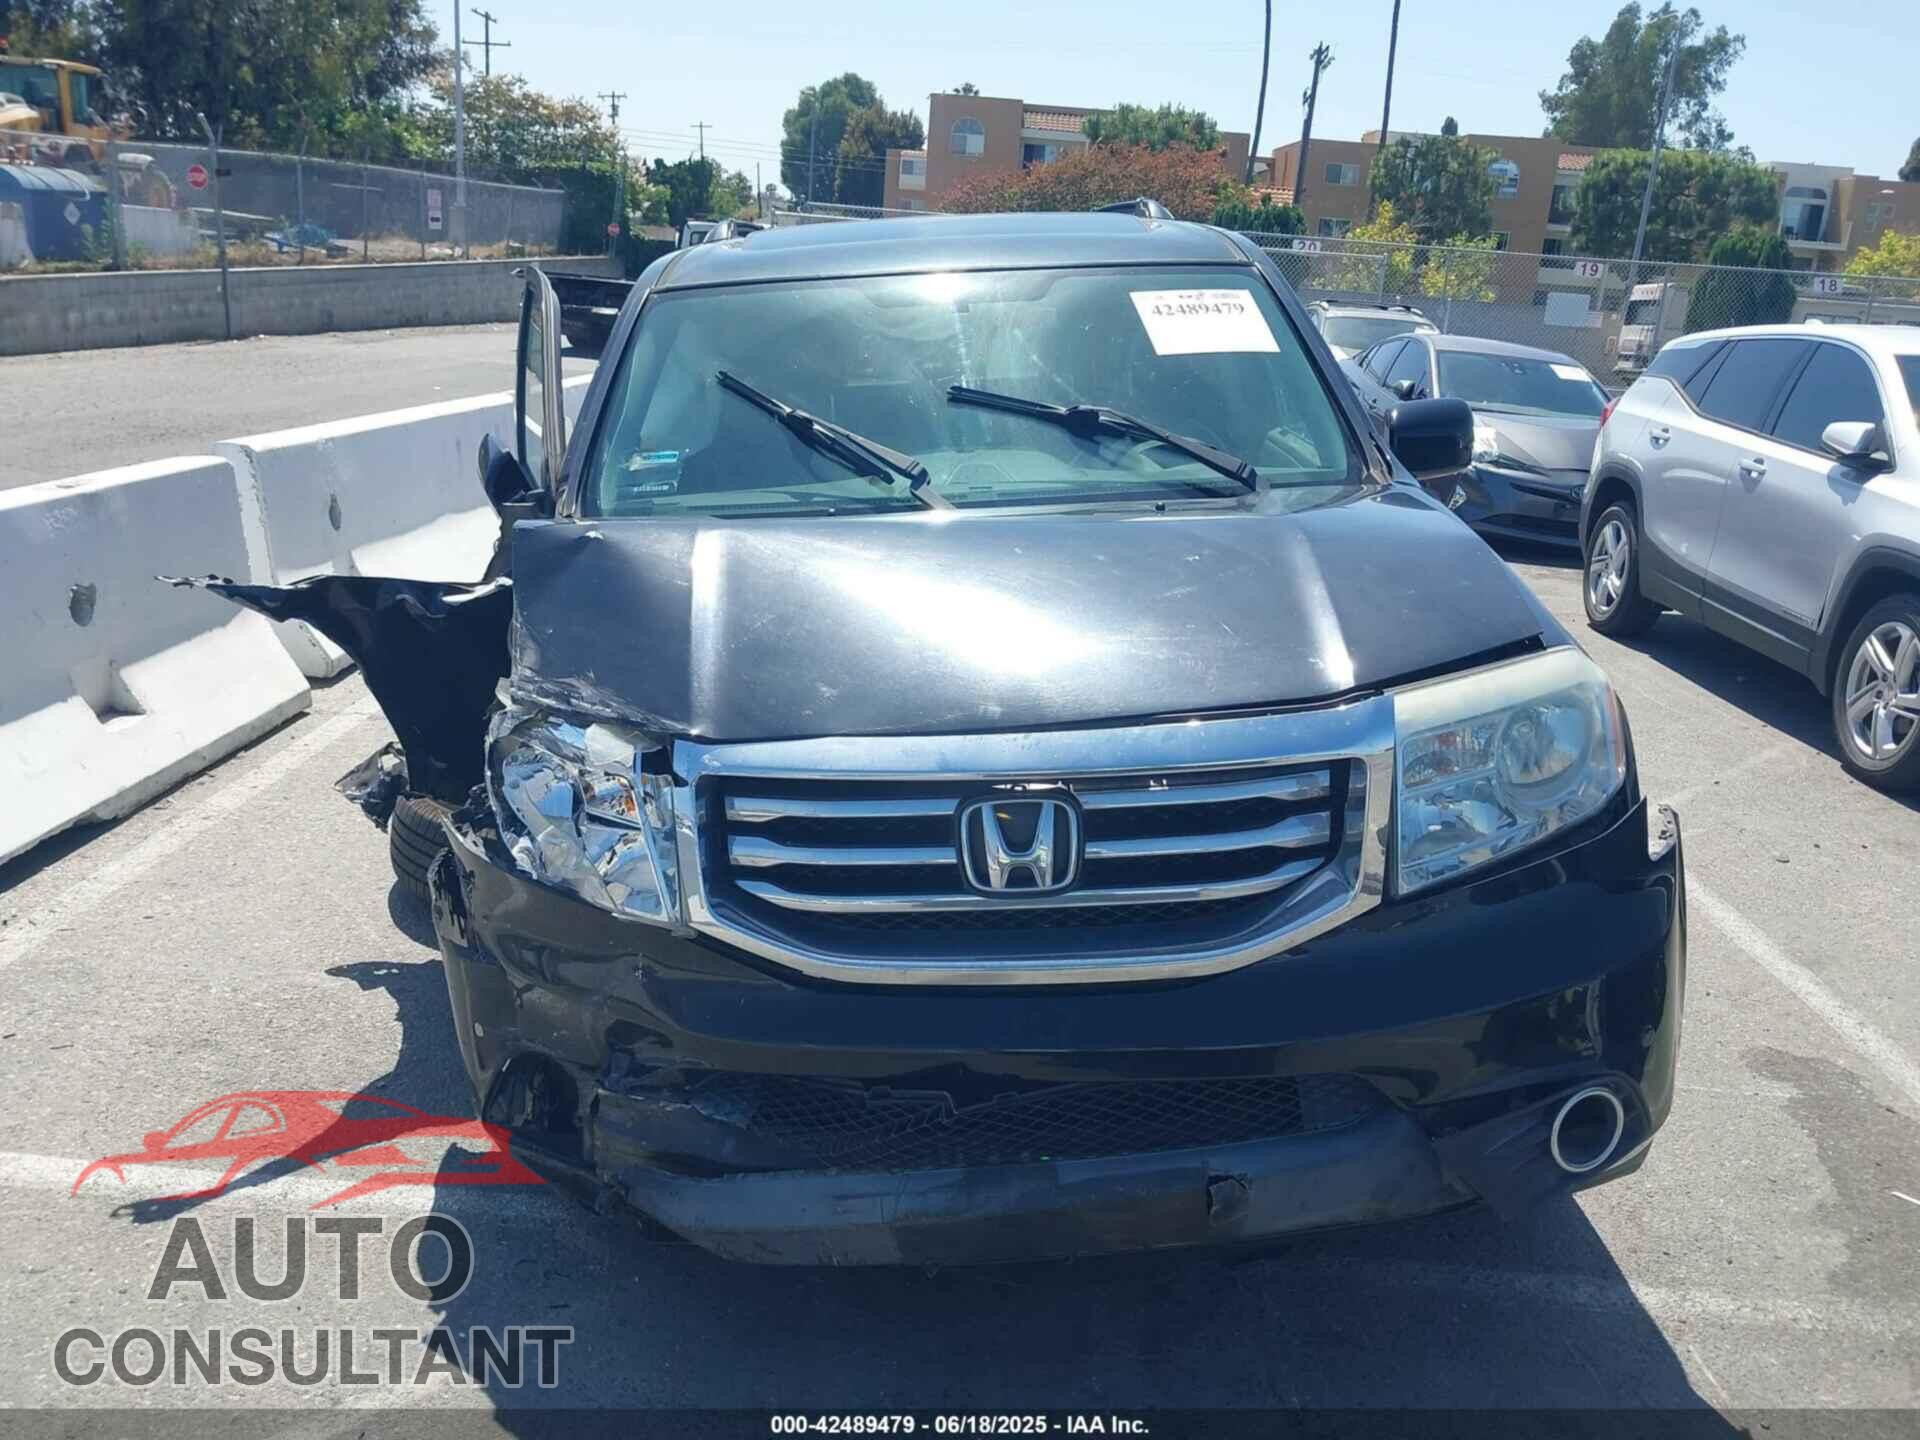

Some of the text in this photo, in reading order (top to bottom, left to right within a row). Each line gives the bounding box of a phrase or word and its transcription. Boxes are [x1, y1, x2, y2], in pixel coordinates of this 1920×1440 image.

[1581, 262, 1599, 277] 19
[1819, 278, 1837, 292] 18
[1152, 302, 1245, 316] 42489479
